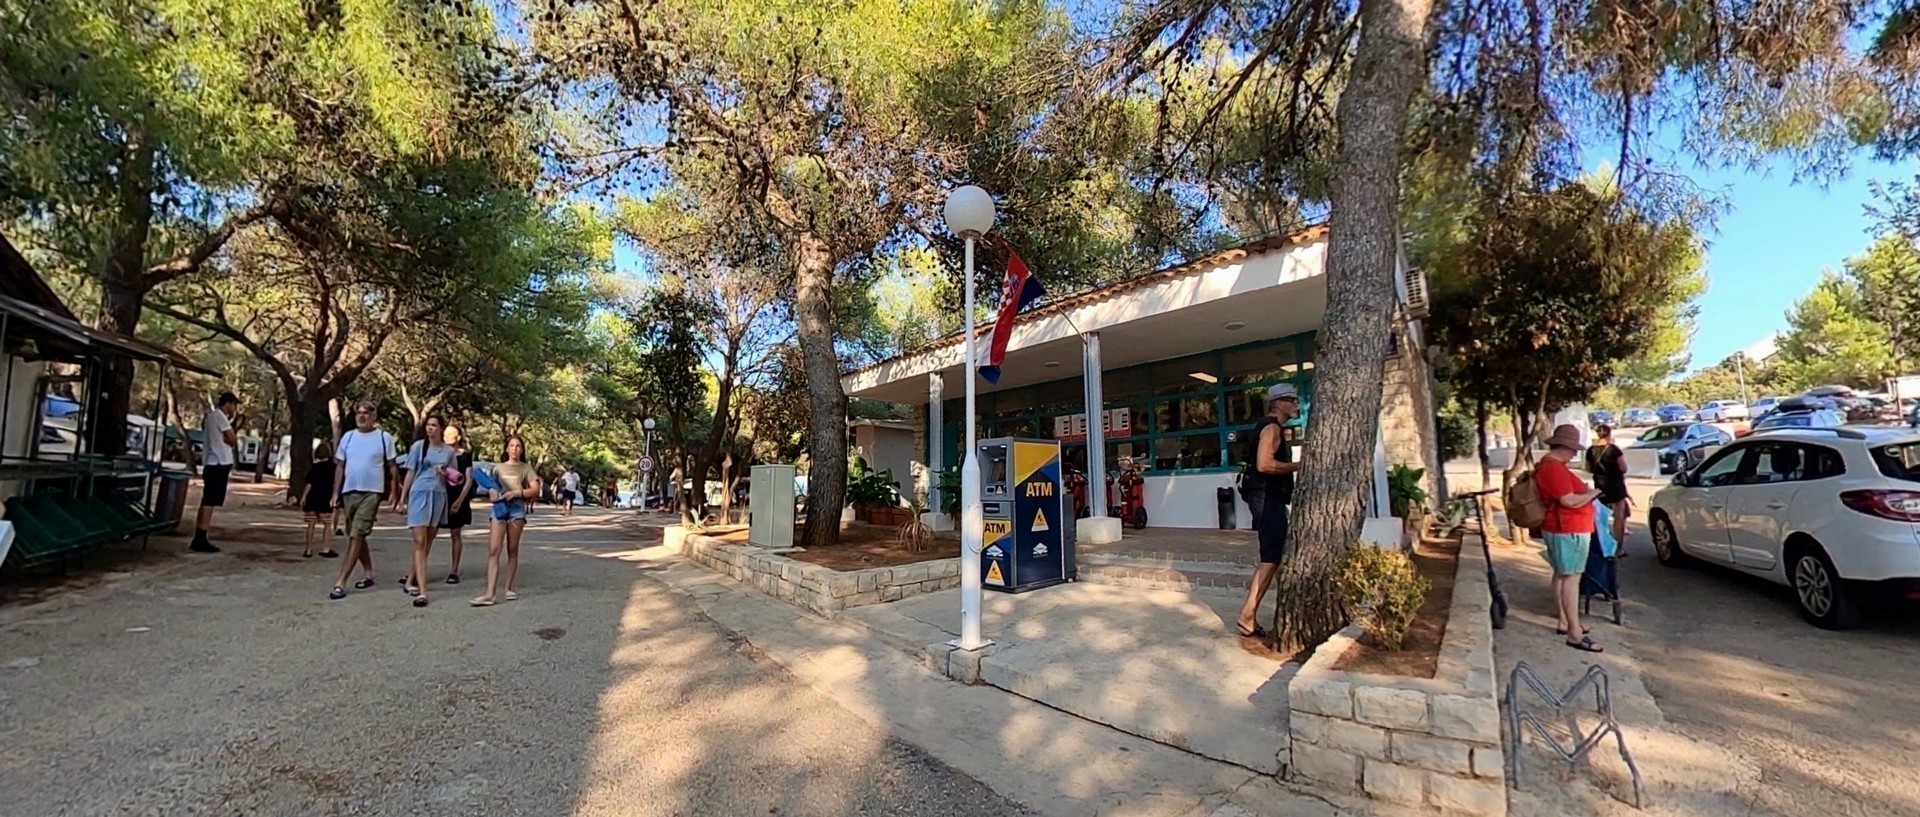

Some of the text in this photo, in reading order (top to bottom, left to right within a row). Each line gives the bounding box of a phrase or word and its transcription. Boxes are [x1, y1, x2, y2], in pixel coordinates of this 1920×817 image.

[641, 460, 650, 468] 20
[1026, 482, 1052, 497] ATM
[984, 522, 1005, 534] ATM
